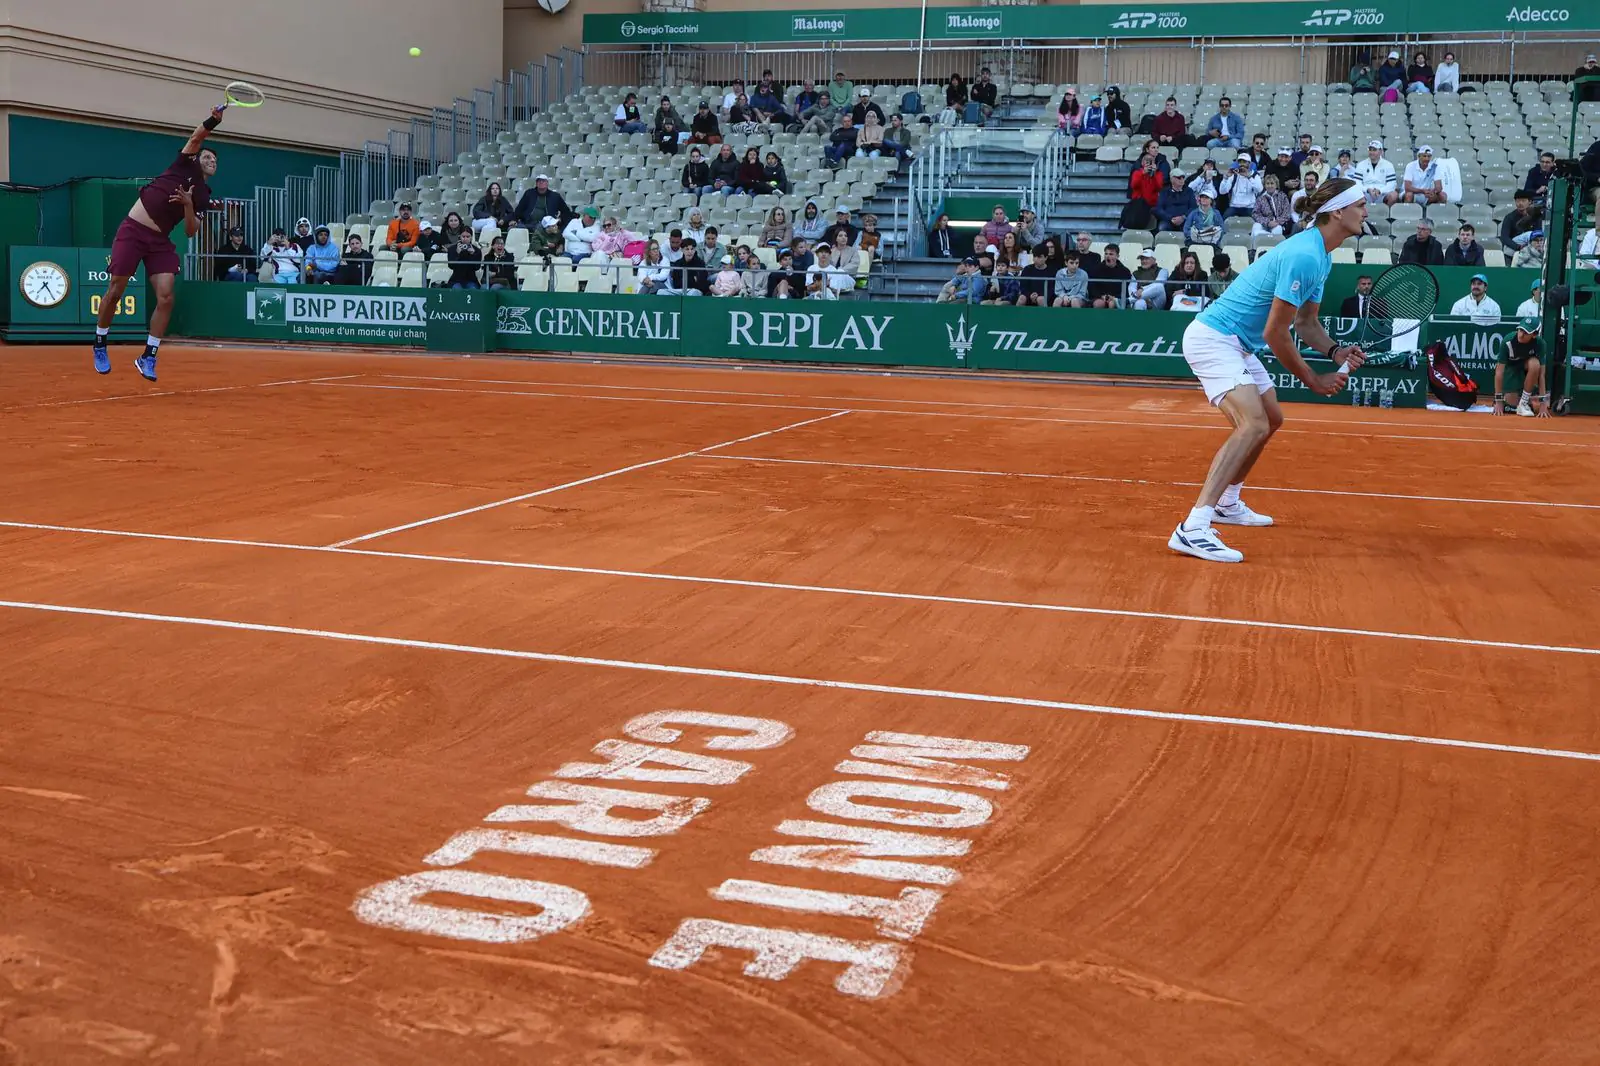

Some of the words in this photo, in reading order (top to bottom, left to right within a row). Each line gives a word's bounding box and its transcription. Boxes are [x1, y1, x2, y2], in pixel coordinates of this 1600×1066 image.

[1108, 12, 1157, 28] ATP
[1301, 9, 1352, 26] ATP
[1352, 13, 1385, 25] 1000
[1505, 5, 1570, 22] Adecco
[637, 25, 664, 36] Sergio
[664, 23, 699, 34] Tacchini
[793, 17, 845, 33] Malongo
[947, 14, 1001, 30] Malongo
[1157, 16, 1188, 28] 1000
[88, 271, 137, 281] ROX
[438, 293, 443, 303] 1
[466, 294, 472, 304] 2
[293, 297, 336, 318] BNP
[429, 310, 481, 322] LANCASTER
[535, 307, 681, 341] GENERALI
[293, 324, 303, 333] La
[305, 324, 335, 335] banque
[337, 326, 355, 336] d'un
[357, 326, 386, 337] monde
[388, 329, 402, 339] qui
[728, 310, 895, 351] REPLAY
[987, 330, 1184, 357] Maserati
[1445, 332, 1504, 360] ALMO
[351, 709, 795, 943] CARLO
[647, 729, 1031, 1000] MONTE
